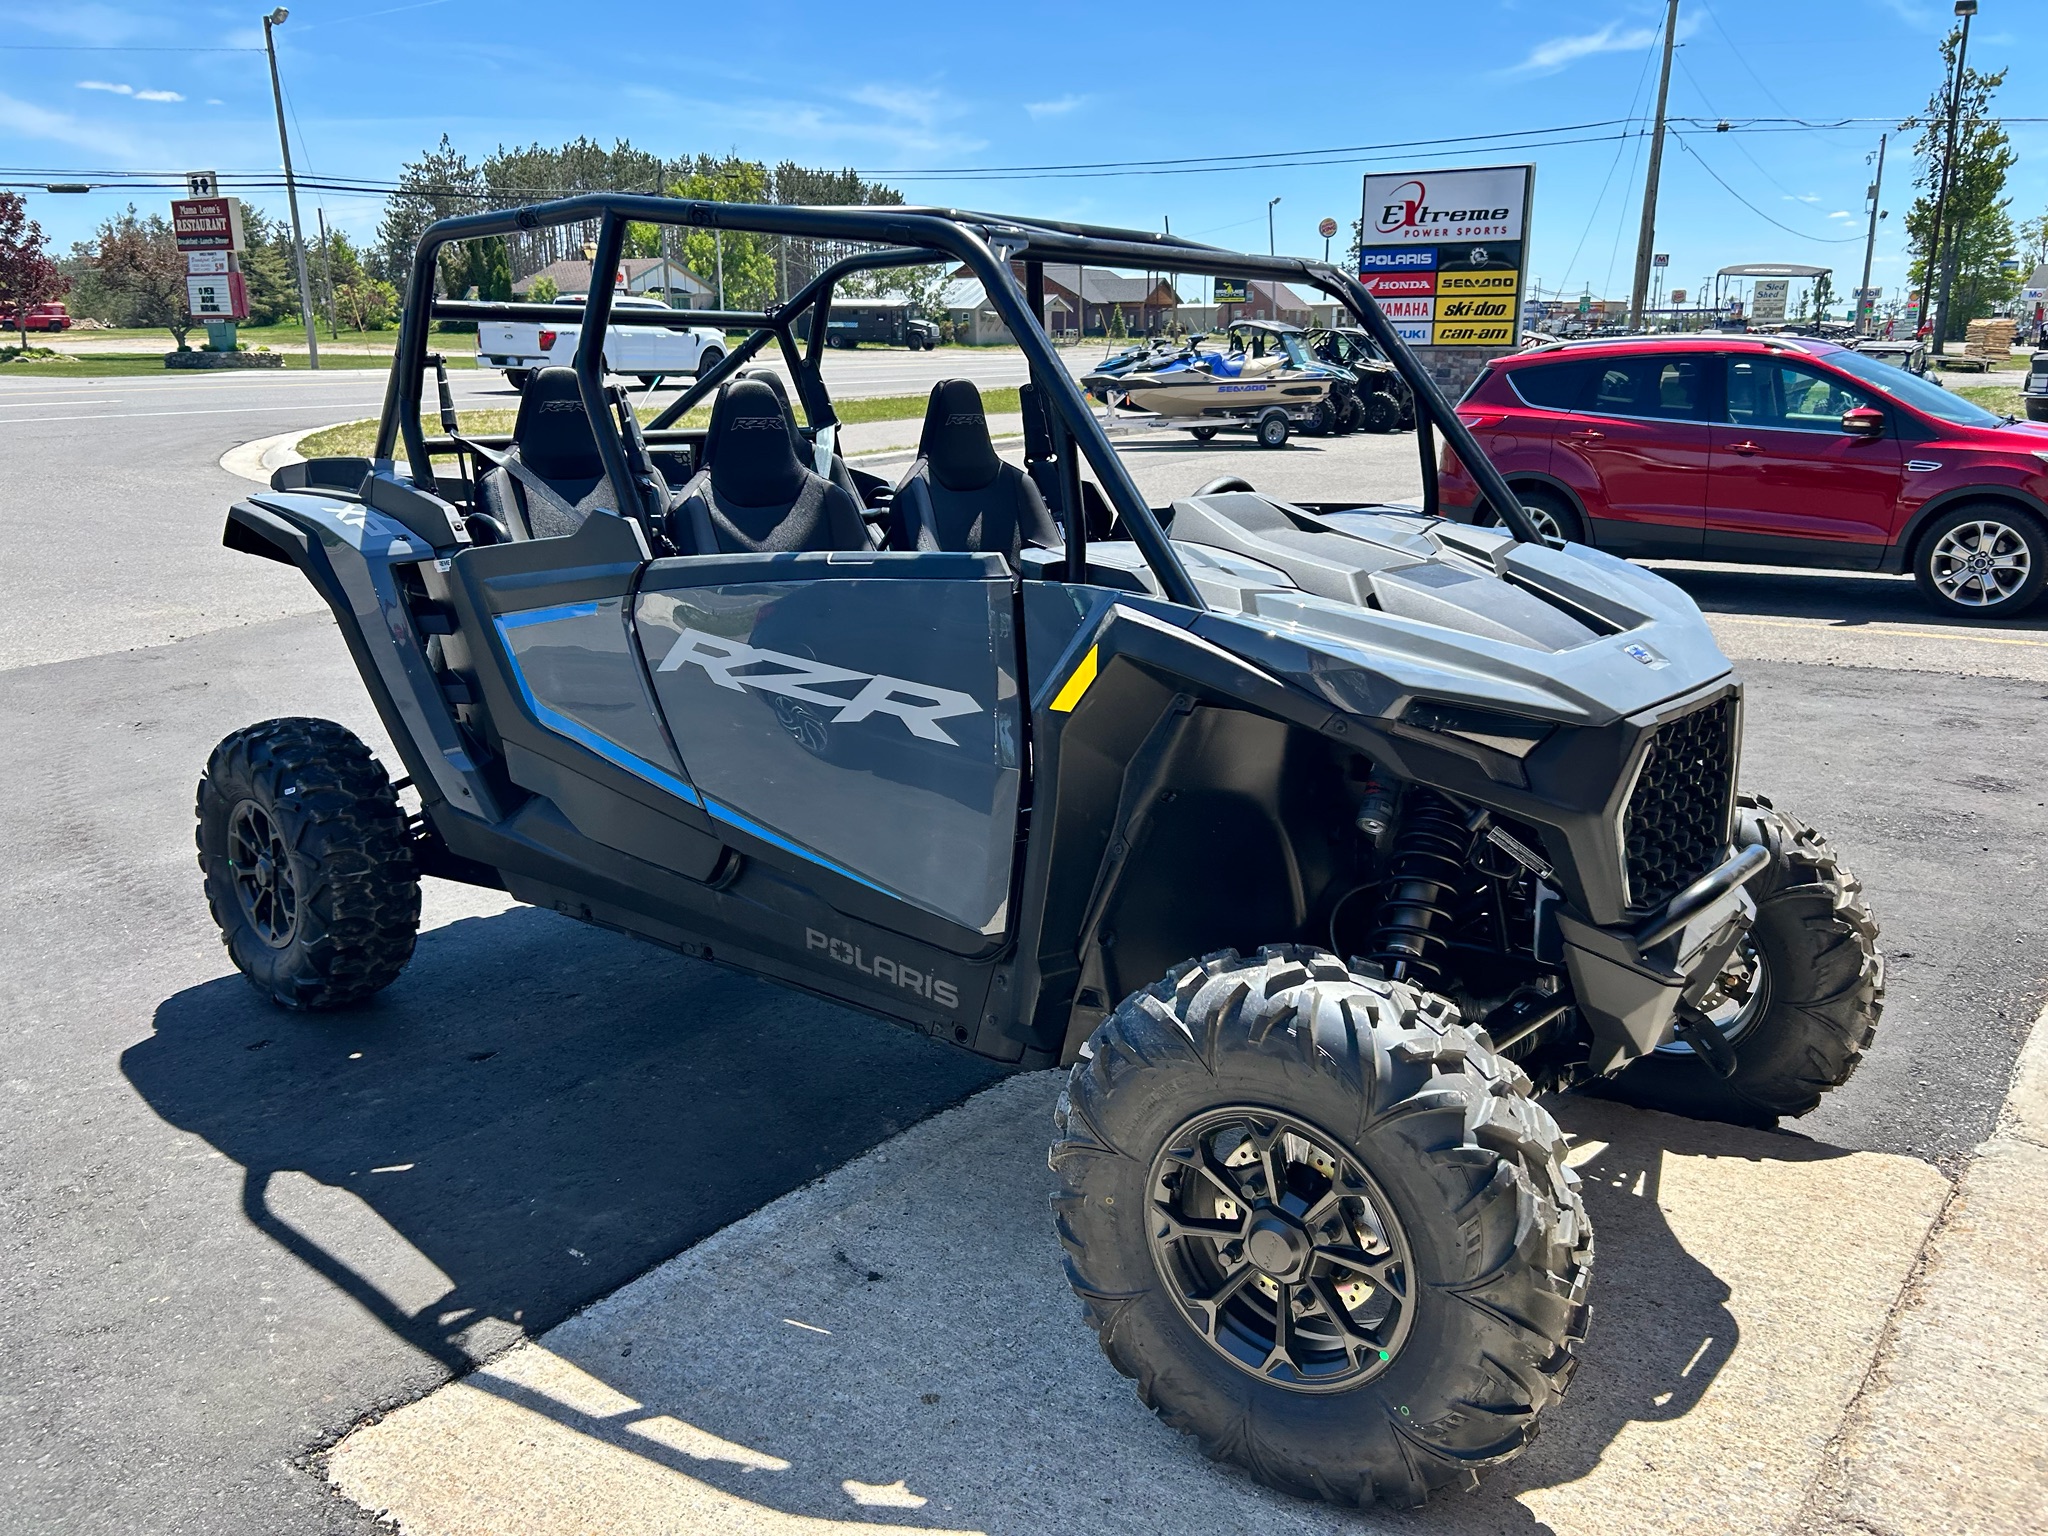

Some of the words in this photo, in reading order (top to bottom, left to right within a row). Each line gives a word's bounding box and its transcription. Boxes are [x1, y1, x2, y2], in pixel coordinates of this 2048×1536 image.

[179, 205, 198, 215] Mama
[199, 204, 220, 214] Leone's
[1376, 189, 1510, 231] Extreme
[176, 217, 227, 232] RESTAURANT
[1404, 228, 1449, 238] POWER
[1456, 226, 1507, 236] SPORTS
[1364, 253, 1433, 267] POLARIS
[198, 287, 215, 295] OPEN
[1378, 280, 1431, 290] HONDA
[1764, 283, 1786, 291] Sled
[201, 295, 215, 303] NOW
[1756, 290, 1780, 299] Shed
[1854, 289, 1880, 297] Mbil
[1444, 301, 1507, 316] ski-doo
[1397, 330, 1426, 339] ZUKI
[1440, 328, 1507, 339] can-am
[731, 417, 782, 431] RZR
[946, 413, 984, 426] RZR
[321, 503, 392, 537] XP
[656, 627, 983, 746] RZR
[805, 926, 959, 1009] POLARIS
